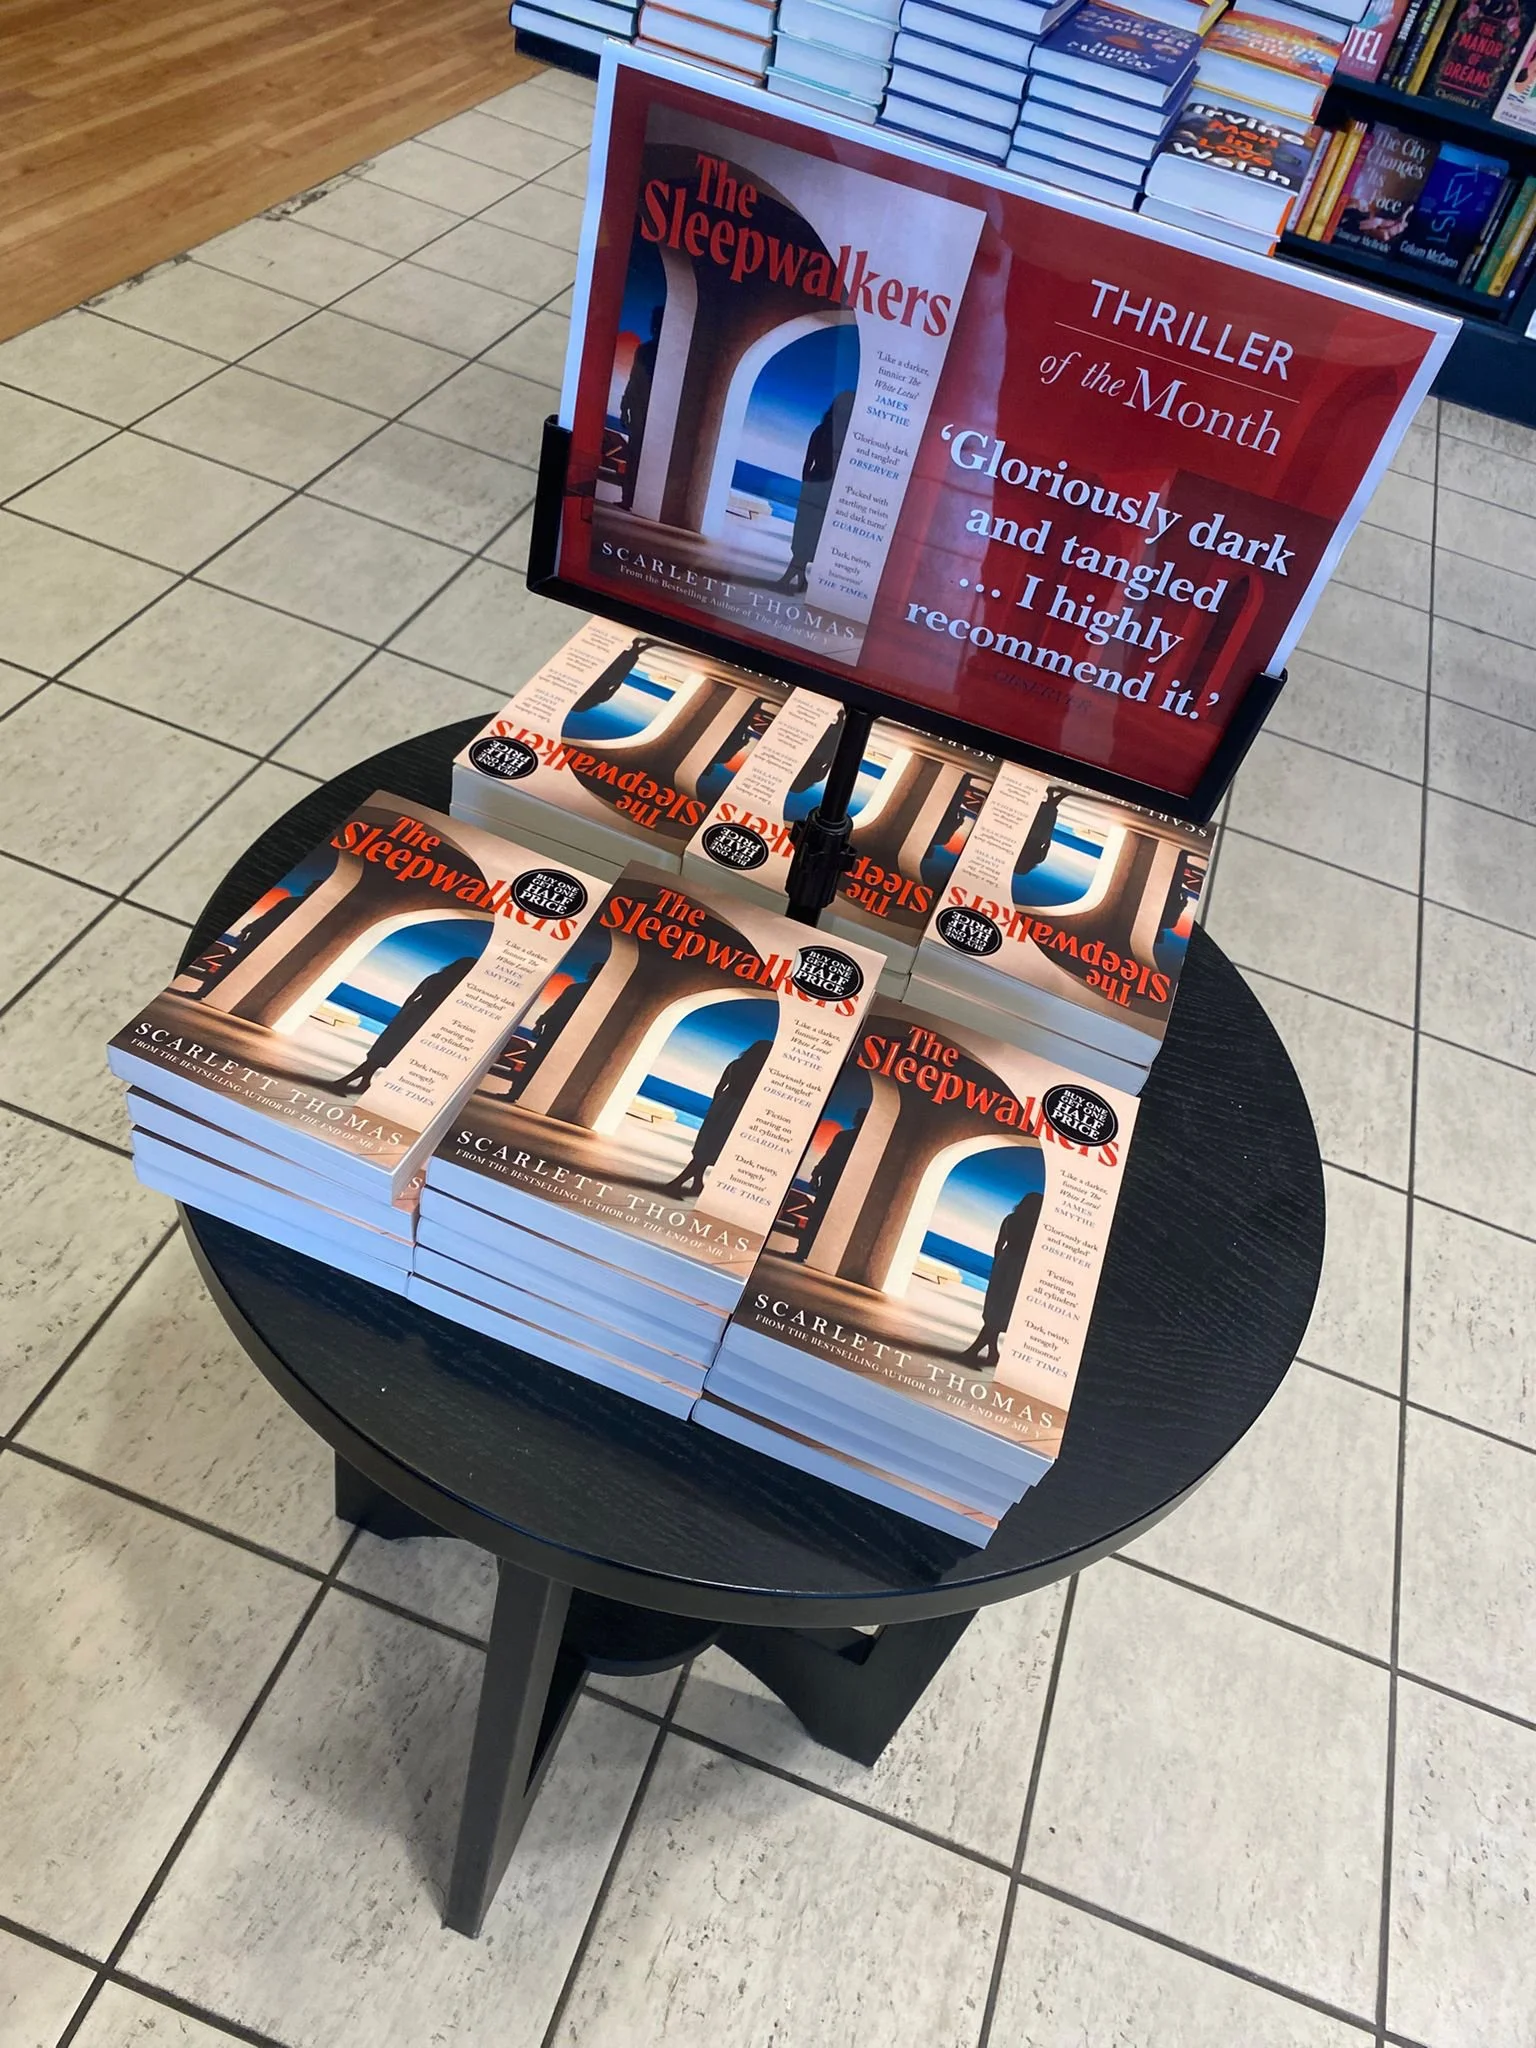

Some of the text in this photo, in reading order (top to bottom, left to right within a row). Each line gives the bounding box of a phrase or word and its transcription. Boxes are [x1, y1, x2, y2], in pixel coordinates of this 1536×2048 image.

[1458, 32, 1504, 58] MANOR
[1444, 62, 1492, 89] DREAMS
[1377, 130, 1431, 162] The City
[1173, 142, 1291, 186] Welsh
[1367, 148, 1426, 180] Changes
[695, 153, 757, 218] The
[640, 179, 952, 337] Sleepwalkers
[1400, 241, 1458, 268] Colum McCann
[1090, 279, 1295, 381] THRILLER
[874, 379, 897, 393] White
[866, 406, 910, 427] SMYTHE
[875, 395, 909, 412] JAMES
[1039, 351, 1283, 456] of the Month
[856, 447, 870, 457] and
[892, 445, 909, 457] dark
[849, 457, 900, 480] OBSERVER
[872, 496, 889, 507] with
[832, 520, 884, 543] GUARDIAN
[835, 509, 849, 519] and
[849, 512, 866, 525] dark
[1188, 511, 1296, 578] dark
[965, 507, 1229, 614] and tangled
[601, 541, 857, 641] SCARLETT THOMAS
[620, 564, 645, 582] From
[644, 574, 660, 587] the
[660, 579, 709, 605] Bestselling
[710, 596, 742, 616] Author
[741, 606, 753, 617] of
[754, 611, 773, 625] The
[818, 576, 869, 600] THE TIMES
[1015, 572, 1044, 611] I
[1046, 583, 1184, 664] highly
[903, 601, 1155, 703] recommend
[489, 719, 709, 828] Sleepwalkers
[615, 794, 662, 831] The
[387, 816, 440, 853] The
[524, 883, 573, 906] HALF
[532, 878, 577, 899] GET ONE
[536, 873, 580, 894] BUY ONE
[518, 891, 567, 914] PRICE
[652, 887, 706, 927] The
[844, 881, 894, 919] The
[948, 920, 990, 942] HALF
[952, 911, 993, 935] PRICE
[801, 961, 849, 986] HALF
[806, 957, 852, 979] GET ONE
[809, 951, 854, 972] BUY ONE
[795, 970, 844, 995] PRICE
[1085, 968, 1133, 1008] The
[901, 1025, 959, 1068] The
[130, 1038, 159, 1057] FROM
[158, 1048, 180, 1066] THE
[179, 1055, 241, 1093] BESTSELLING
[241, 1085, 284, 1113] AUTHOR
[284, 1105, 299, 1118] OF
[299, 1111, 320, 1130] THE
[320, 1122, 341, 1140] END
[340, 1132, 354, 1144] OF
[135, 1022, 403, 1147] SCARLETT THOMAS
[1055, 1101, 1104, 1130] HALF
[1060, 1095, 1106, 1123] GET ONE
[1064, 1090, 1108, 1116] BUY ONE
[1051, 1110, 1100, 1140] PRICE
[455, 1148, 486, 1167] FROM
[487, 1160, 509, 1175] THE
[509, 1169, 579, 1201] BESTSELLING
[579, 1198, 624, 1221] AUTHOR
[625, 1213, 640, 1224] OF
[642, 1219, 664, 1236] THE
[664, 1228, 688, 1244] END
[689, 1238, 705, 1249] OF
[456, 1130, 750, 1252] SCARLETT THOMAS
[1026, 1296, 1080, 1322] GUARDIAN
[754, 1293, 1055, 1430] SCARLETT THOMAS
[755, 1313, 787, 1332] FROM
[787, 1326, 811, 1342] THE
[810, 1336, 880, 1373] BESTSELLING
[881, 1367, 928, 1392] AUTHOR
[928, 1385, 945, 1398] OF
[945, 1392, 969, 1409] THE
[969, 1402, 994, 1419] END
[994, 1414, 1010, 1427] OF
[1011, 1350, 1068, 1378] THE TIMES
